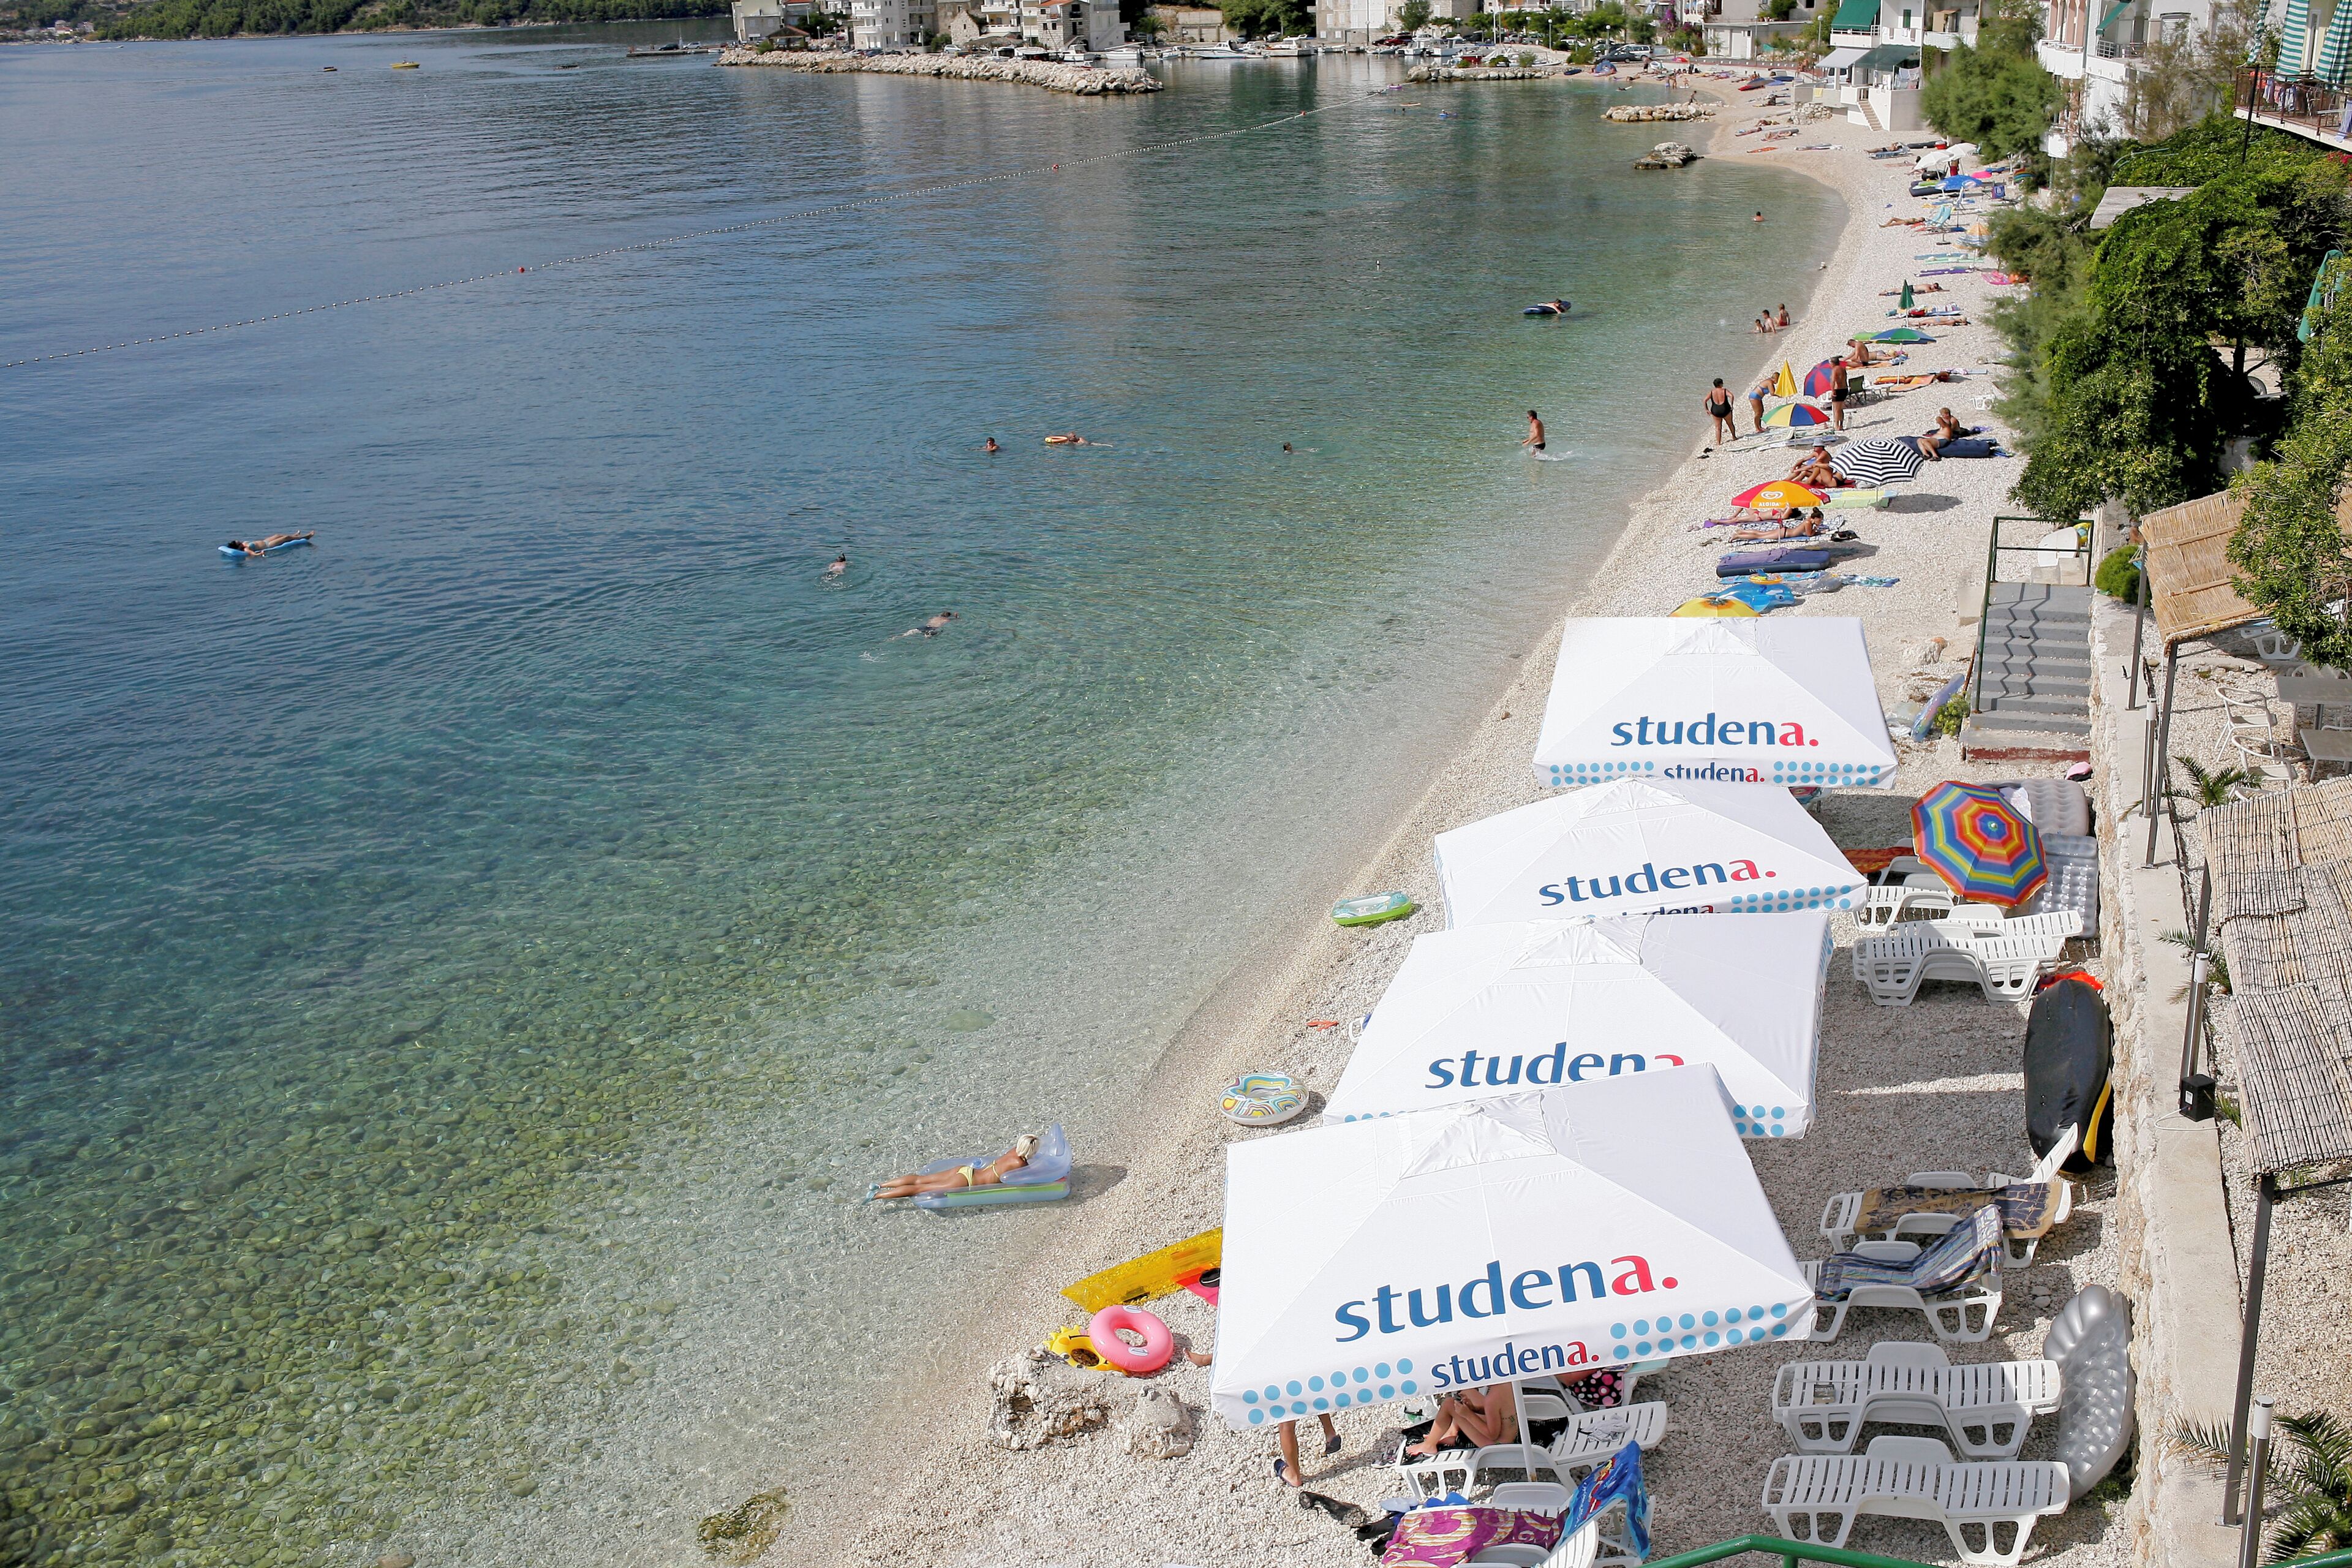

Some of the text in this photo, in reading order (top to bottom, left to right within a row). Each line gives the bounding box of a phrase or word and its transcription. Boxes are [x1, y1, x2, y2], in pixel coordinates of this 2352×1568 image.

[1611, 712, 1819, 747] studena.
[1664, 762, 1765, 782] studena.
[1539, 859, 1776, 906] studena.
[1335, 1255, 1678, 1343] studena.
[1431, 1341, 1600, 1388] studena.
